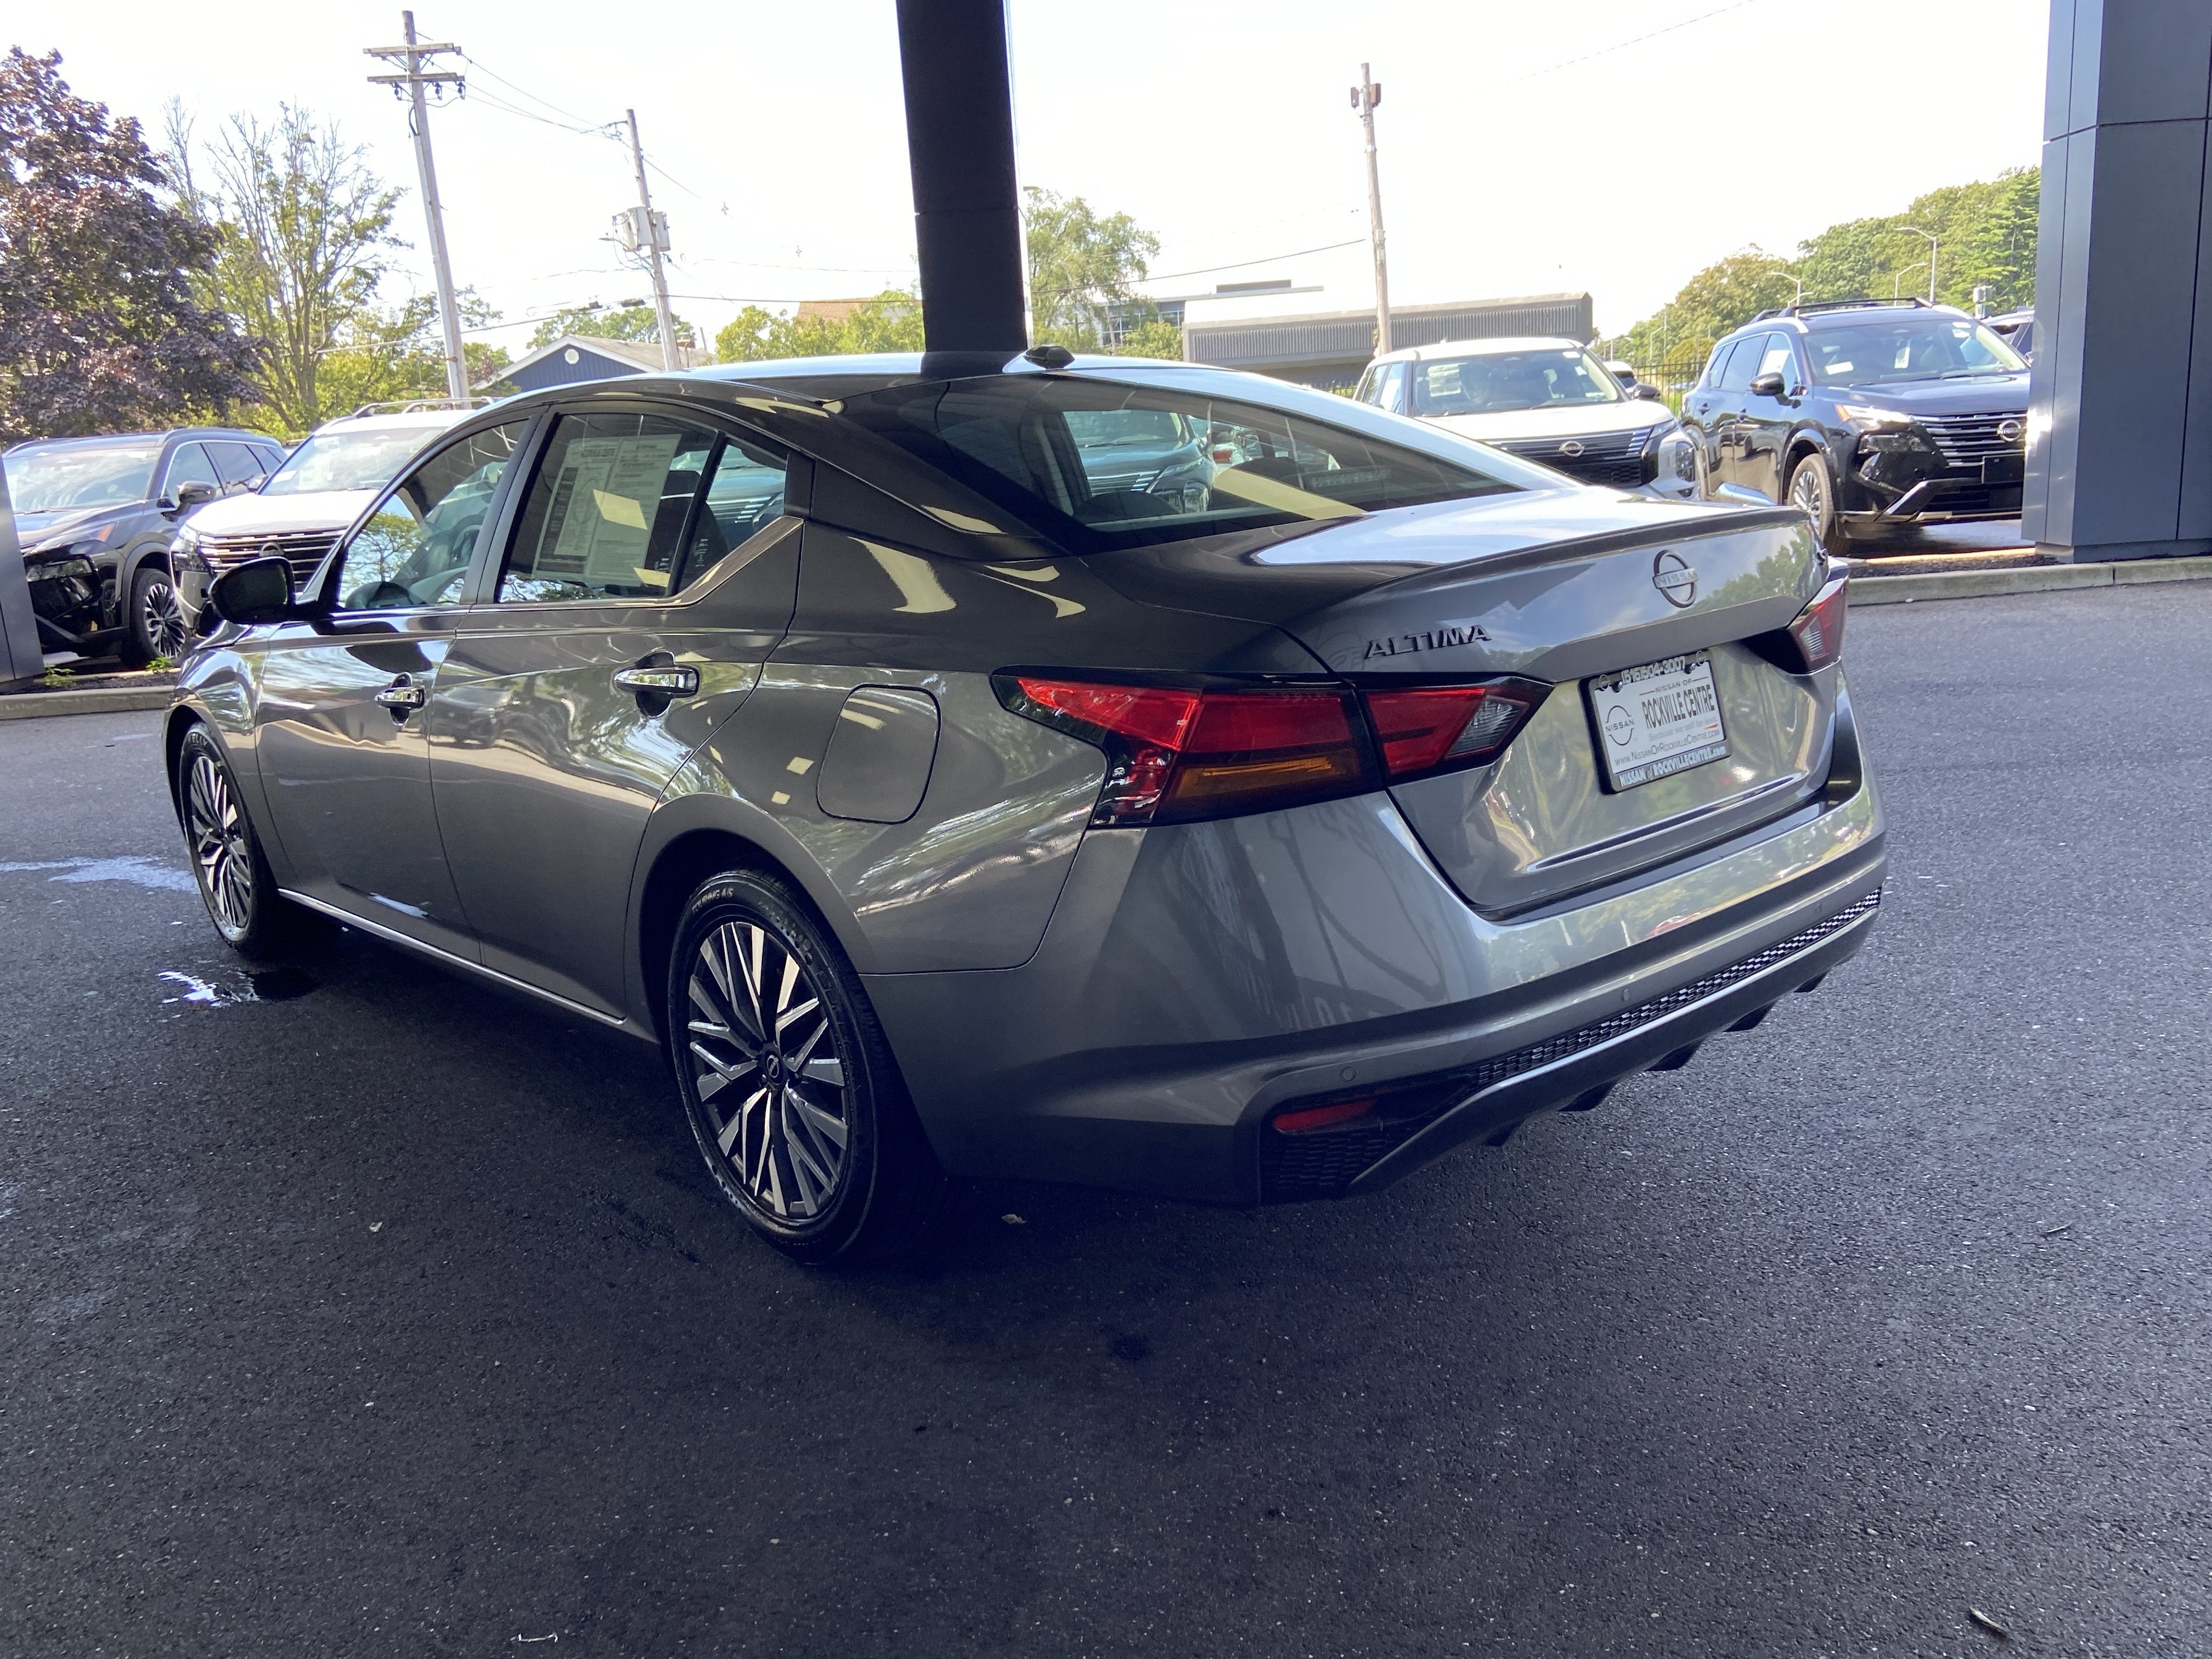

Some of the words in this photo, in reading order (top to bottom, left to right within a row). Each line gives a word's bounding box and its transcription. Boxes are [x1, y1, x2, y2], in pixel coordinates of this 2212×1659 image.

[1657, 570, 1699, 586] NISSAN
[1364, 625, 1492, 659] ALTIMA
[1655, 682, 1680, 693] NISSAN
[1641, 692, 1685, 730] ROCKVILLE
[1683, 684, 1714, 718] CENTRE
[1605, 719, 1634, 732] NISSAN
[1619, 768, 1646, 787] NISSAN
[1646, 765, 1655, 781] of
